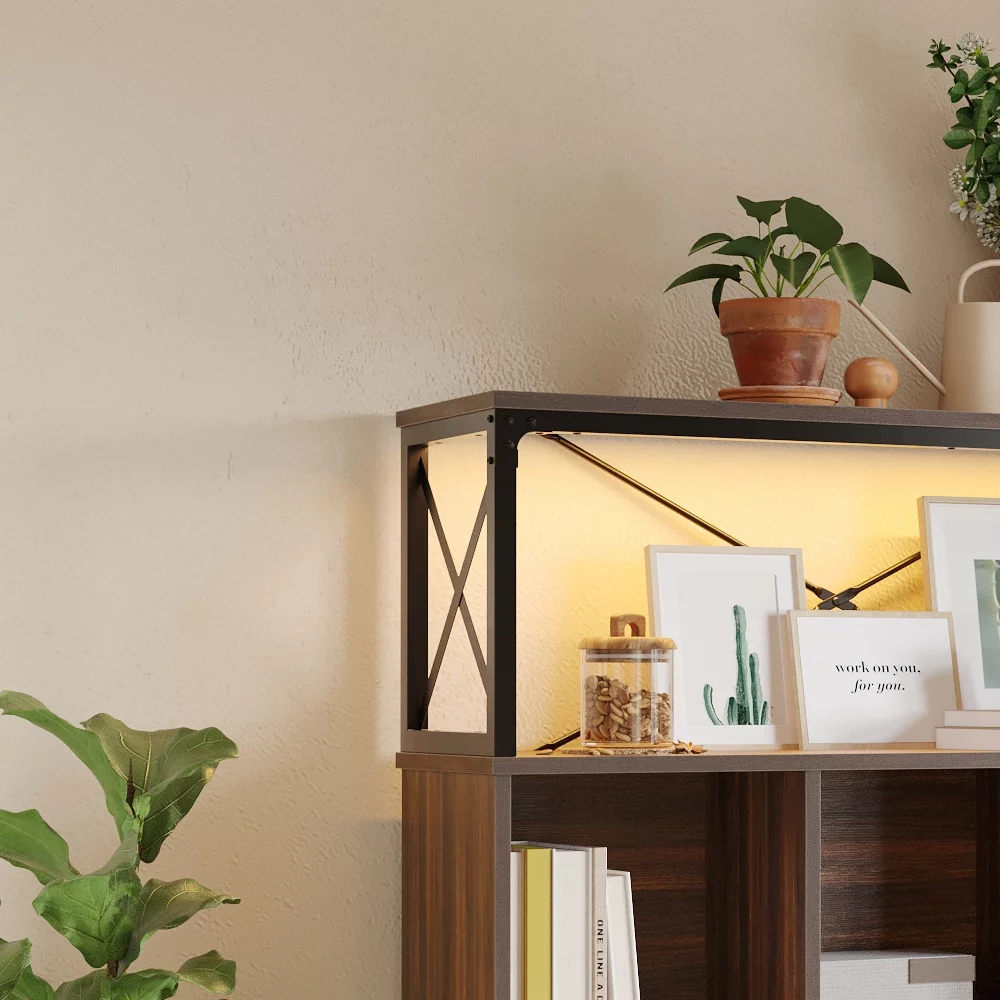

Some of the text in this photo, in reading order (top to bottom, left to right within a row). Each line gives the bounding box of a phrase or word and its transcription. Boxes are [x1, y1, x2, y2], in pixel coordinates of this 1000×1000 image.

[835, 661, 870, 673] work
[873, 664, 890, 673] on
[851, 679, 906, 694] for you.
